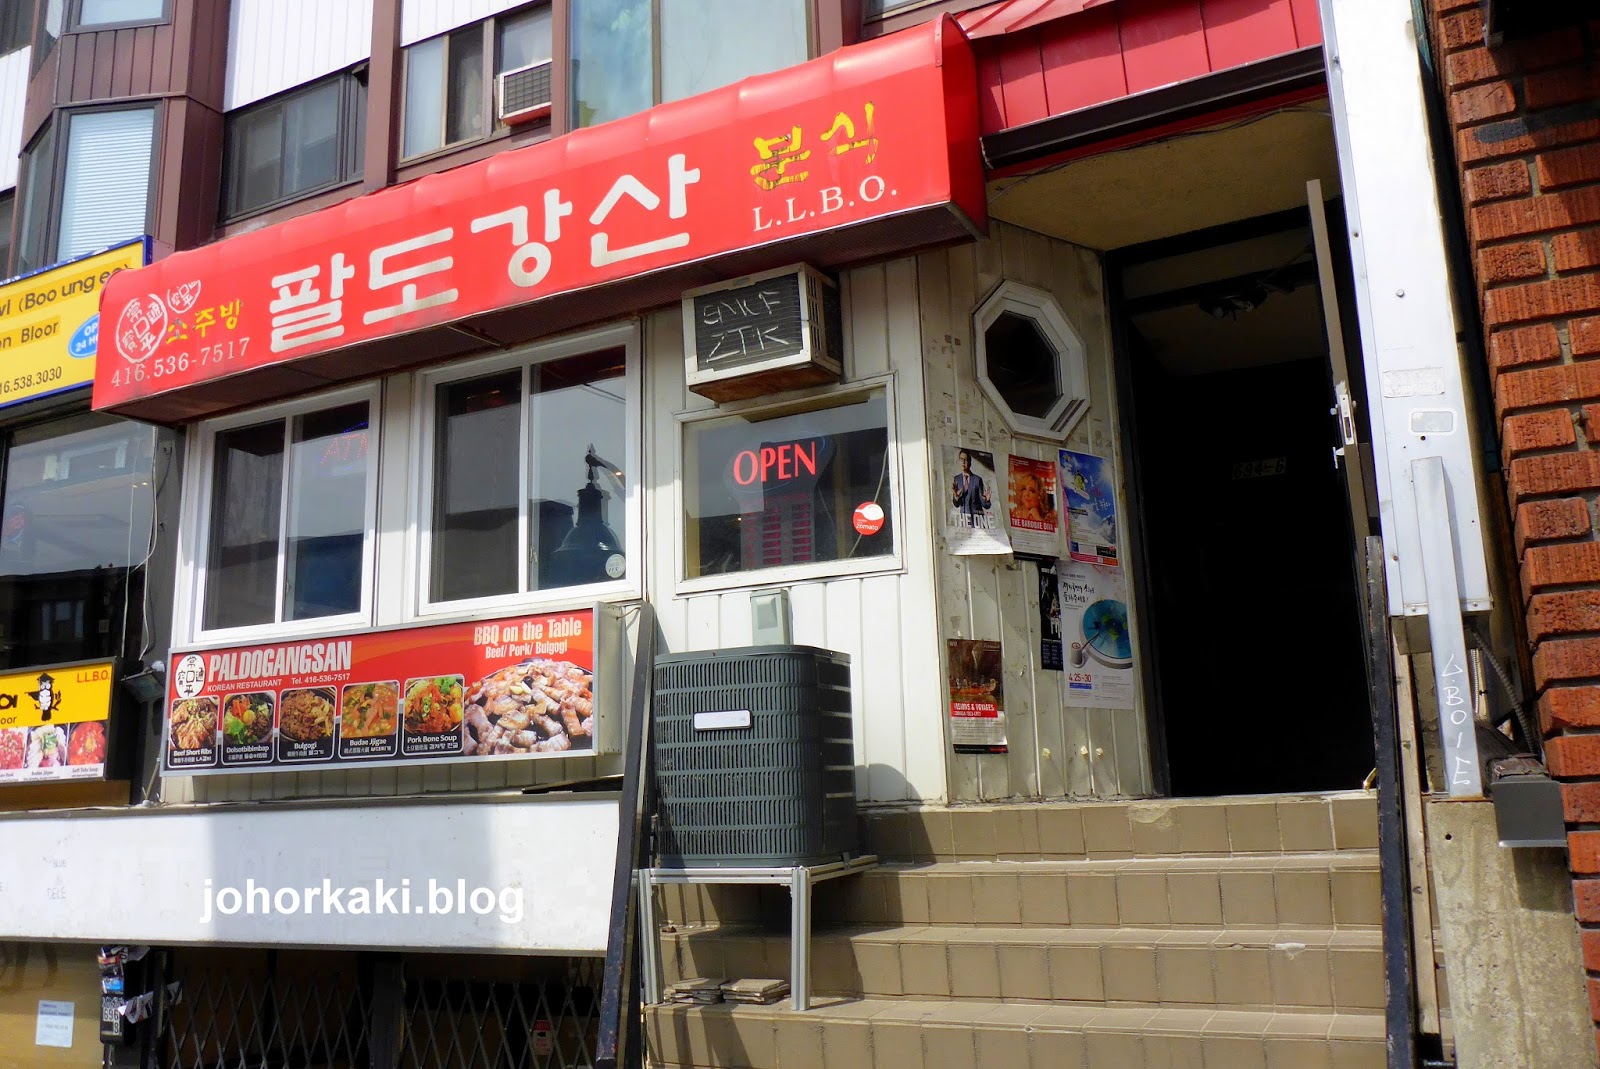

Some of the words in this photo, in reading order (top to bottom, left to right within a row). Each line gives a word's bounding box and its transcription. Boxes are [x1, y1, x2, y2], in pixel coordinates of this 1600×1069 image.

[750, 101, 879, 191] 분식
[753, 175, 898, 231] L.L.B.O.
[269, 153, 701, 353] 팔도강산
[21, 322, 59, 344] Bloor
[112, 336, 250, 388] 416.536-7517
[732, 441, 817, 486] OPEN
[474, 624, 500, 646] BBQ
[502, 626, 519, 643] on
[522, 621, 544, 640] the
[547, 617, 582, 639] Table
[535, 639, 568, 655] Bulgogi
[208, 641, 352, 683] PALDOGANGSAN
[207, 684, 236, 693] KOREAN
[236, 678, 282, 690] RESTAURANT
[304, 673, 351, 684] 416-536-7517
[294, 741, 317, 750] Bulgogi
[349, 739, 369, 747] Budae
[407, 736, 422, 744] Pork
[440, 734, 458, 743] Soup
